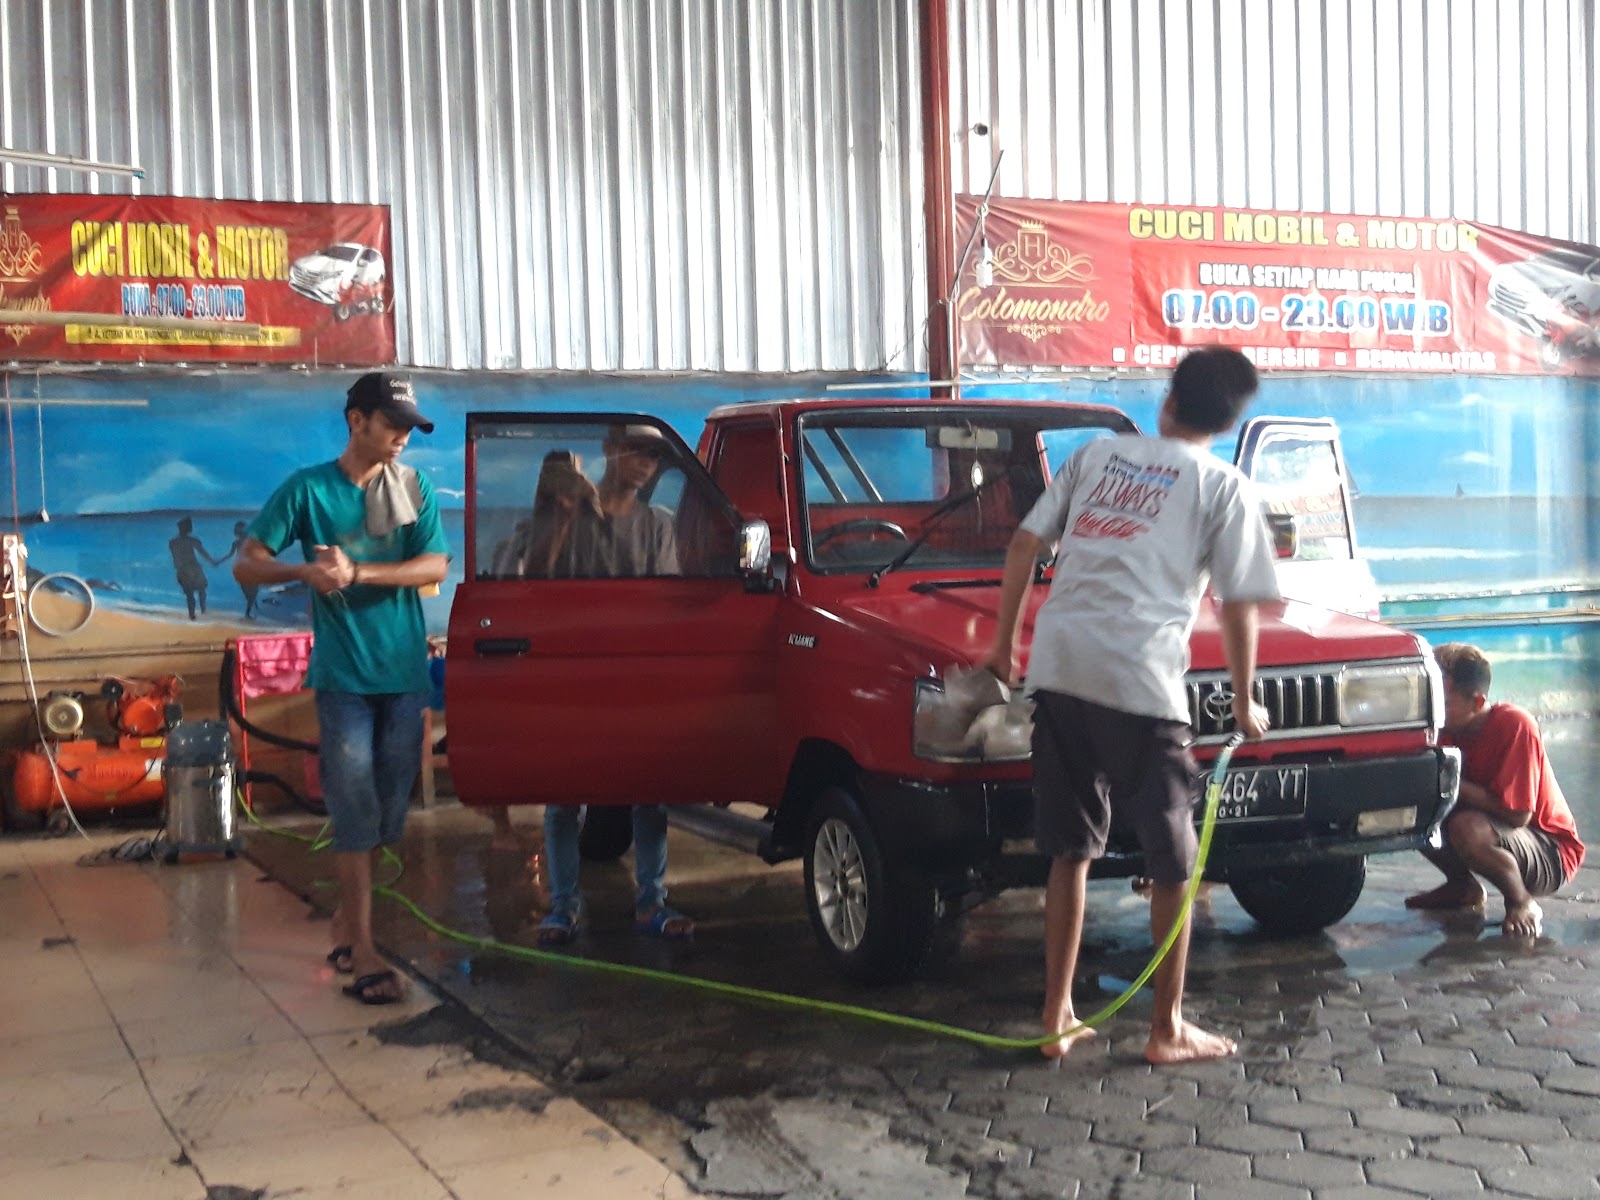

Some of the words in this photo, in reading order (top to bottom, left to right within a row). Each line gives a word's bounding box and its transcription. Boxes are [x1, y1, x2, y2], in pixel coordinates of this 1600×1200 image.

[70, 218, 124, 277] CUCI
[126, 221, 194, 279] MOBIL
[196, 231, 214, 278] &
[216, 225, 289, 281] MOTOR
[1024, 237, 1041, 258] H
[1128, 207, 1214, 241] CUCI
[1222, 212, 1328, 247] MOBIL
[1335, 220, 1361, 248] &
[1367, 220, 1479, 253] MOTOR
[1199, 262, 1251, 287] BUKA
[1252, 264, 1314, 289] SETIAP
[121, 283, 151, 318] BUKA
[222, 285, 246, 321] WIB
[1162, 289, 1258, 330] 07.00
[1282, 293, 1379, 331] 23.00
[1082, 475, 1169, 519] ALWAYS
[1277, 768, 1304, 800] YT
